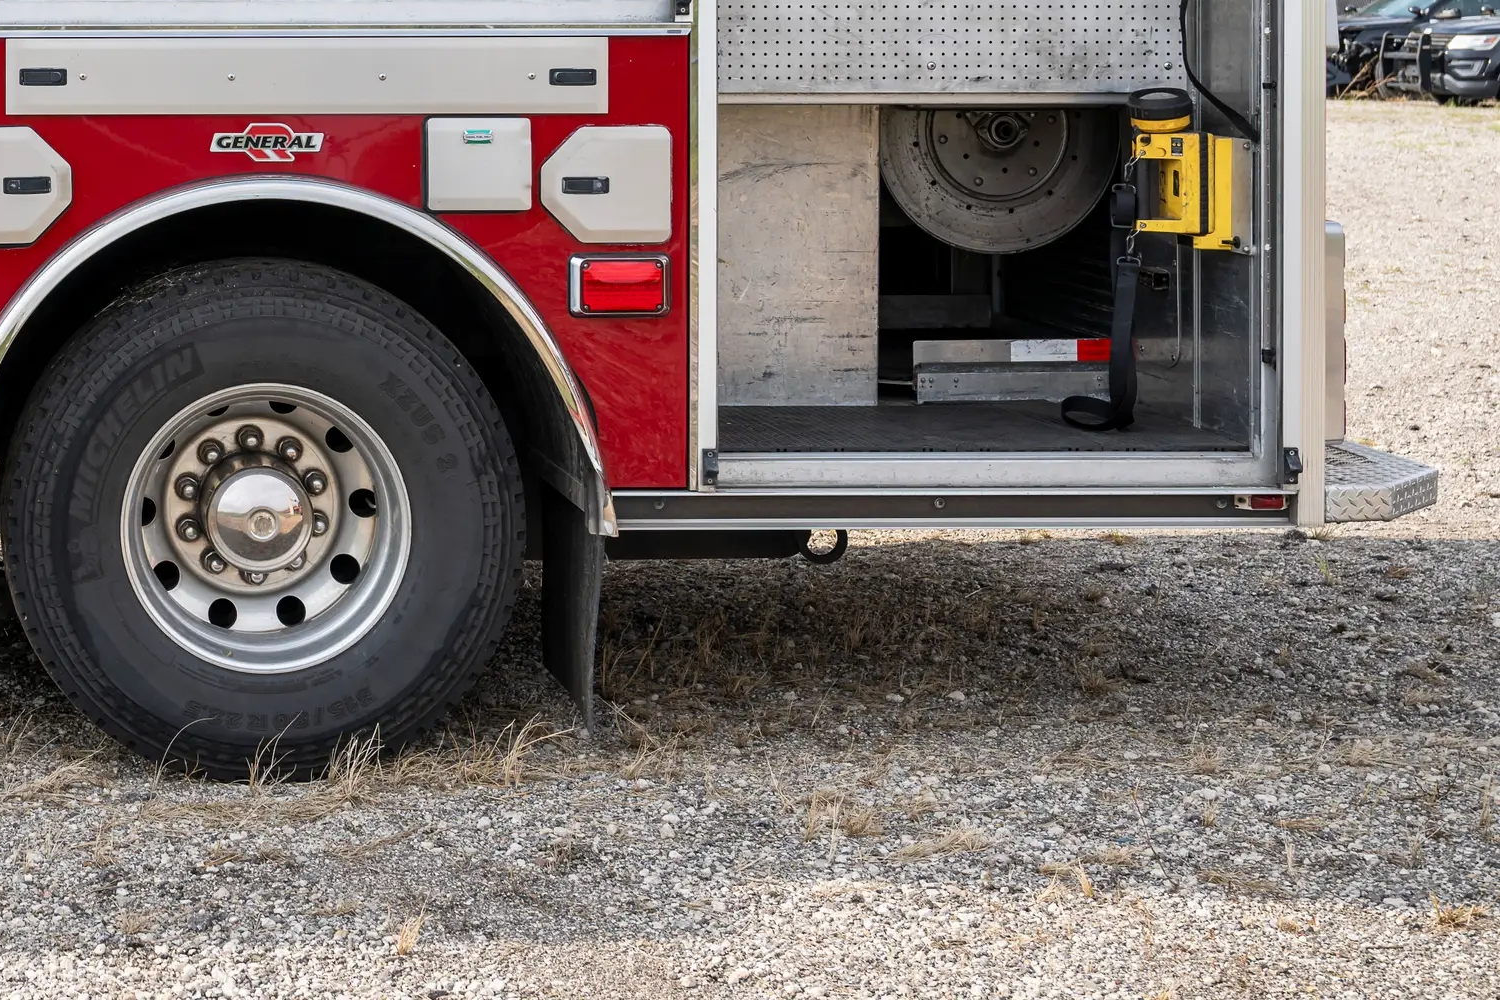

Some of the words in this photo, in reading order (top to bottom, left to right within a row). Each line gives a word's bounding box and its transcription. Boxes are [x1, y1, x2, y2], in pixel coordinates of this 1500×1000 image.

[216, 135, 317, 149] GENERAL
[69, 347, 194, 523] MICHELIN
[377, 371, 445, 445] XZUS
